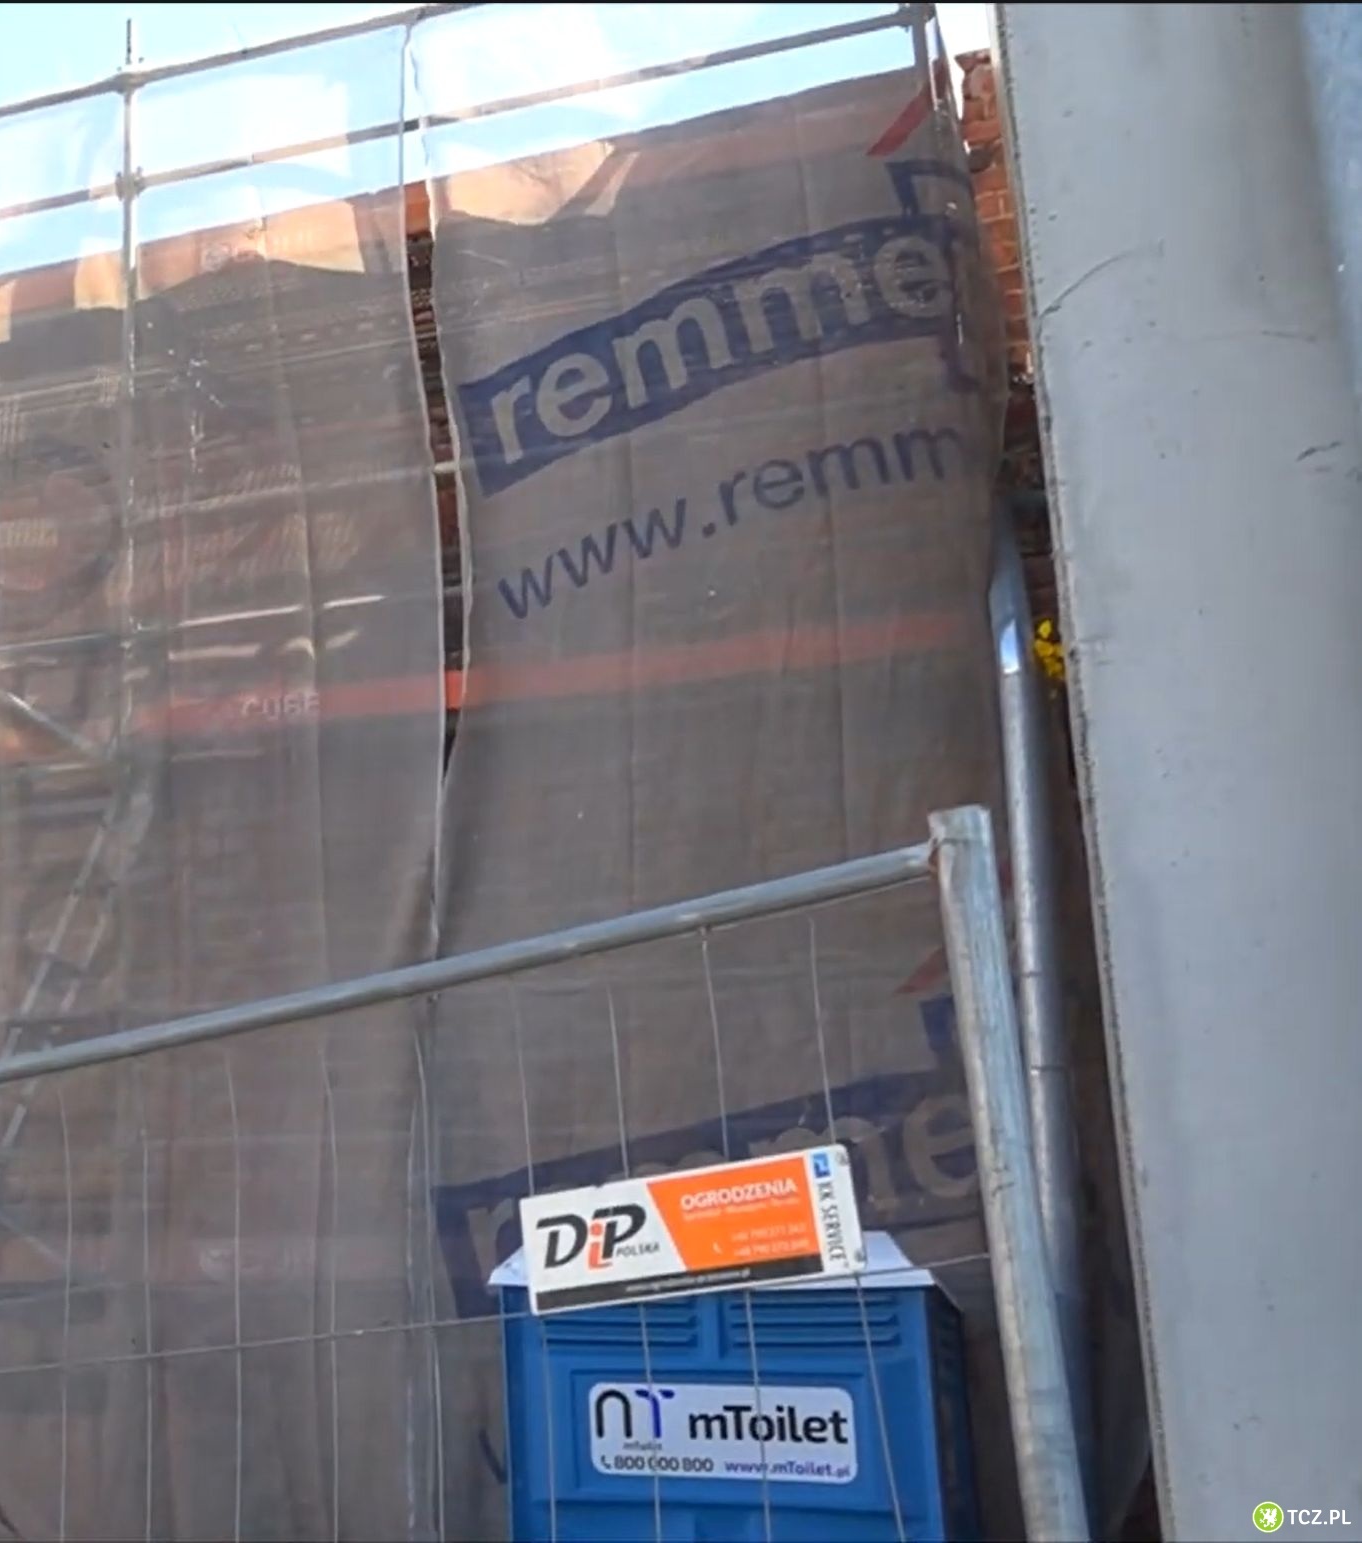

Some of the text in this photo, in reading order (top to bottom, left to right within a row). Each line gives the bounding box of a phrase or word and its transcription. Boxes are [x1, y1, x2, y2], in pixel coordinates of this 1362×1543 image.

[680, 1178, 799, 1211] OGRODZENIA
[821, 1203, 847, 1262] SERVICE
[615, 1241, 660, 1258] POLSKA
[688, 1404, 849, 1445] mToilet
[614, 1455, 715, 1473] 800 000 800
[724, 1460, 851, 1479] www.mToilet.pl
